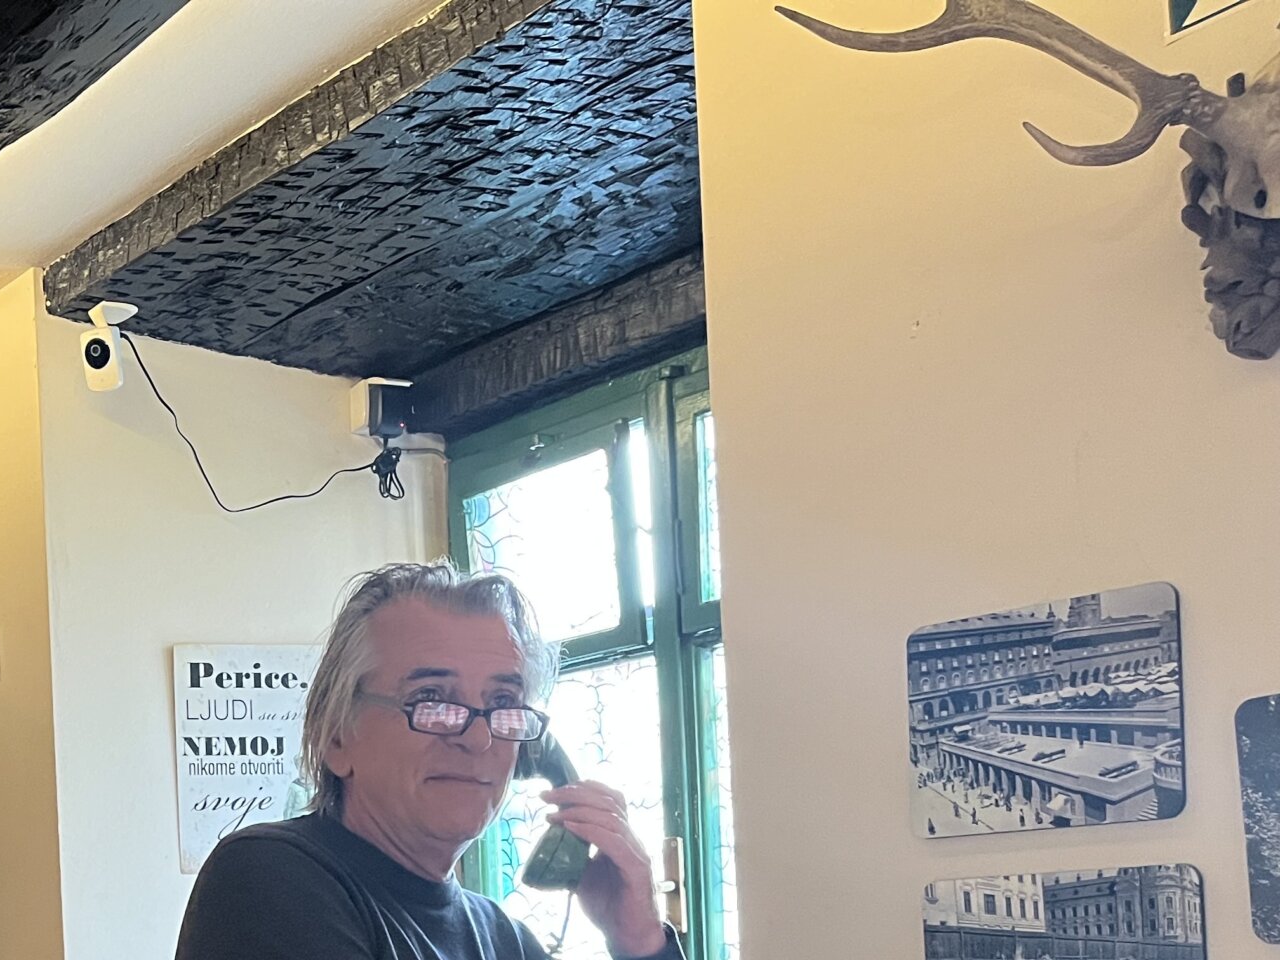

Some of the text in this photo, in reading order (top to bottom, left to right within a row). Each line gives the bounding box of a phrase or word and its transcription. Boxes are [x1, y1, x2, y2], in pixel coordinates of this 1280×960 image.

[187, 661, 309, 694] Perice,
[186, 699, 253, 721] LJUDI
[258, 711, 277, 721] su
[182, 736, 285, 756] NEMOJ
[188, 758, 285, 776] nikome otvoriti
[191, 786, 275, 840] svoje
